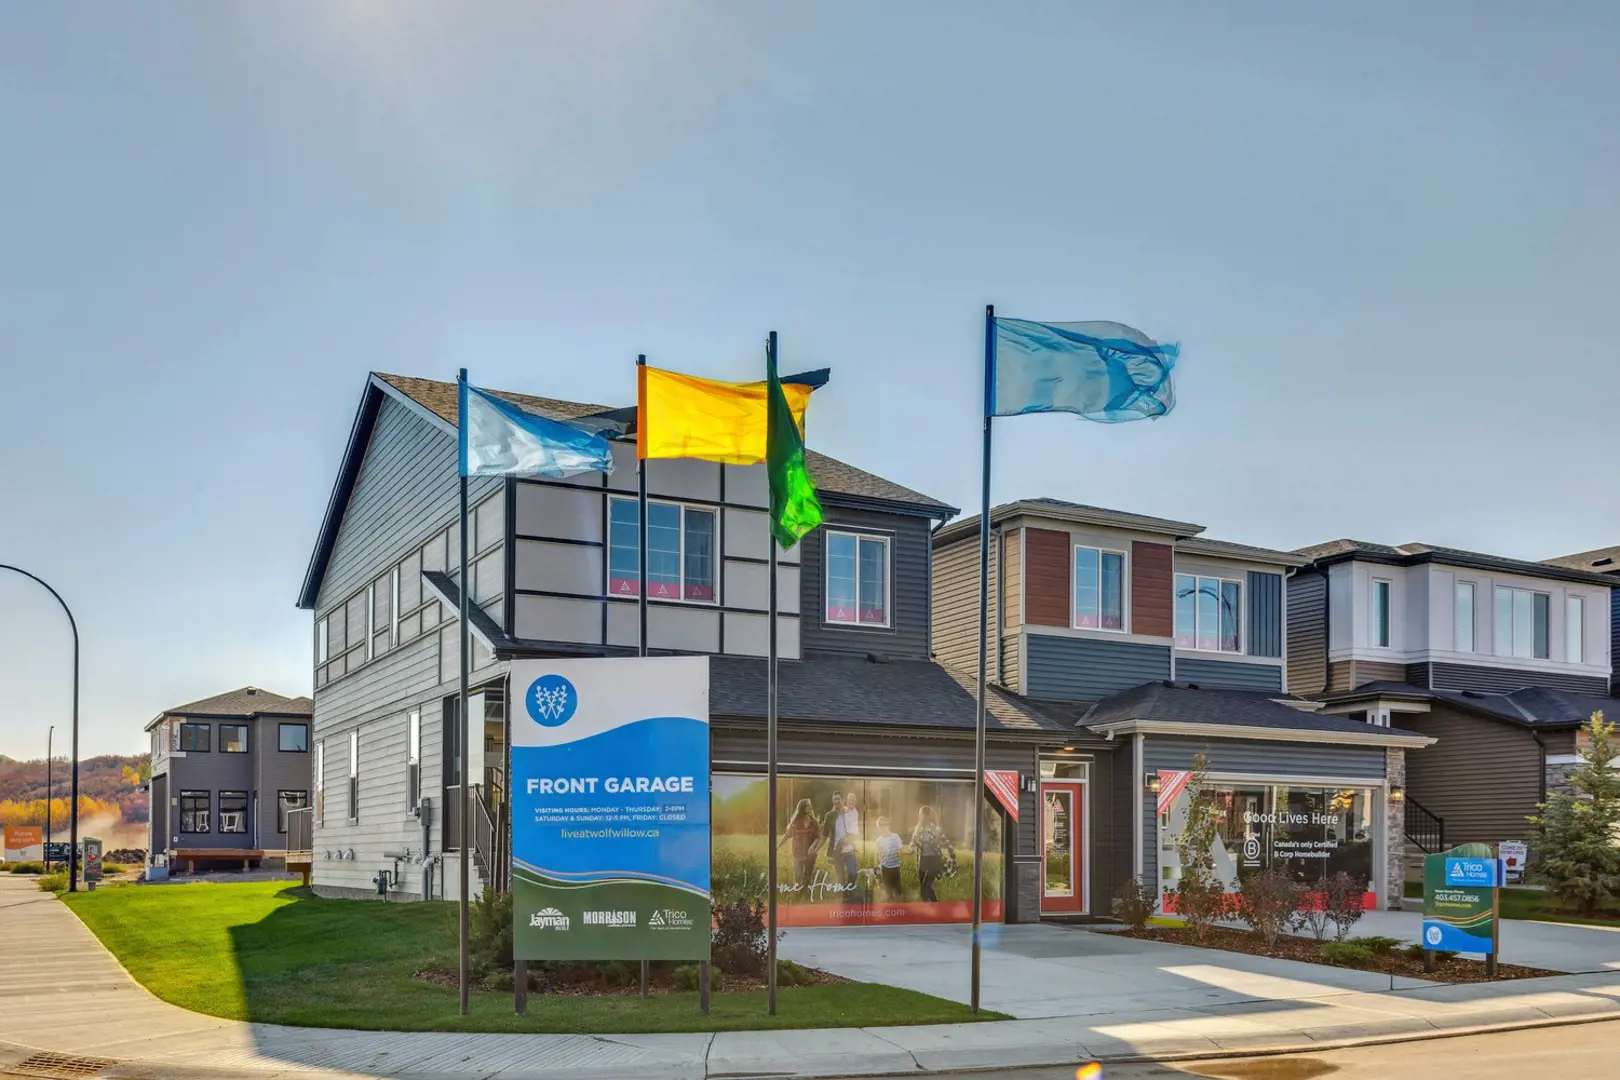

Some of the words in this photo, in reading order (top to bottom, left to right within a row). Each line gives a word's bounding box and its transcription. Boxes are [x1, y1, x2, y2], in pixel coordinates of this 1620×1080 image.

[526, 777, 599, 794] FRONT
[604, 776, 694, 794] GARAGE
[1244, 810, 1276, 824] Good
[1279, 811, 1309, 824] Lives
[1311, 811, 1338, 825] Here
[561, 828, 660, 839] liveatwolfwillow.ca
[1273, 840, 1300, 848] Canada's
[1301, 840, 1313, 849] only
[1313, 840, 1338, 848] Certified
[1273, 850, 1279, 858] B
[1279, 850, 1294, 859] Corp
[1294, 850, 1331, 858] Homebuilder
[1462, 861, 1483, 872] Trico
[808, 869, 857, 902] Home
[662, 908, 688, 919] Trico
[829, 908, 905, 918] tricohomes.com
[529, 913, 570, 930] Jayman
[668, 918, 693, 926] Homes
